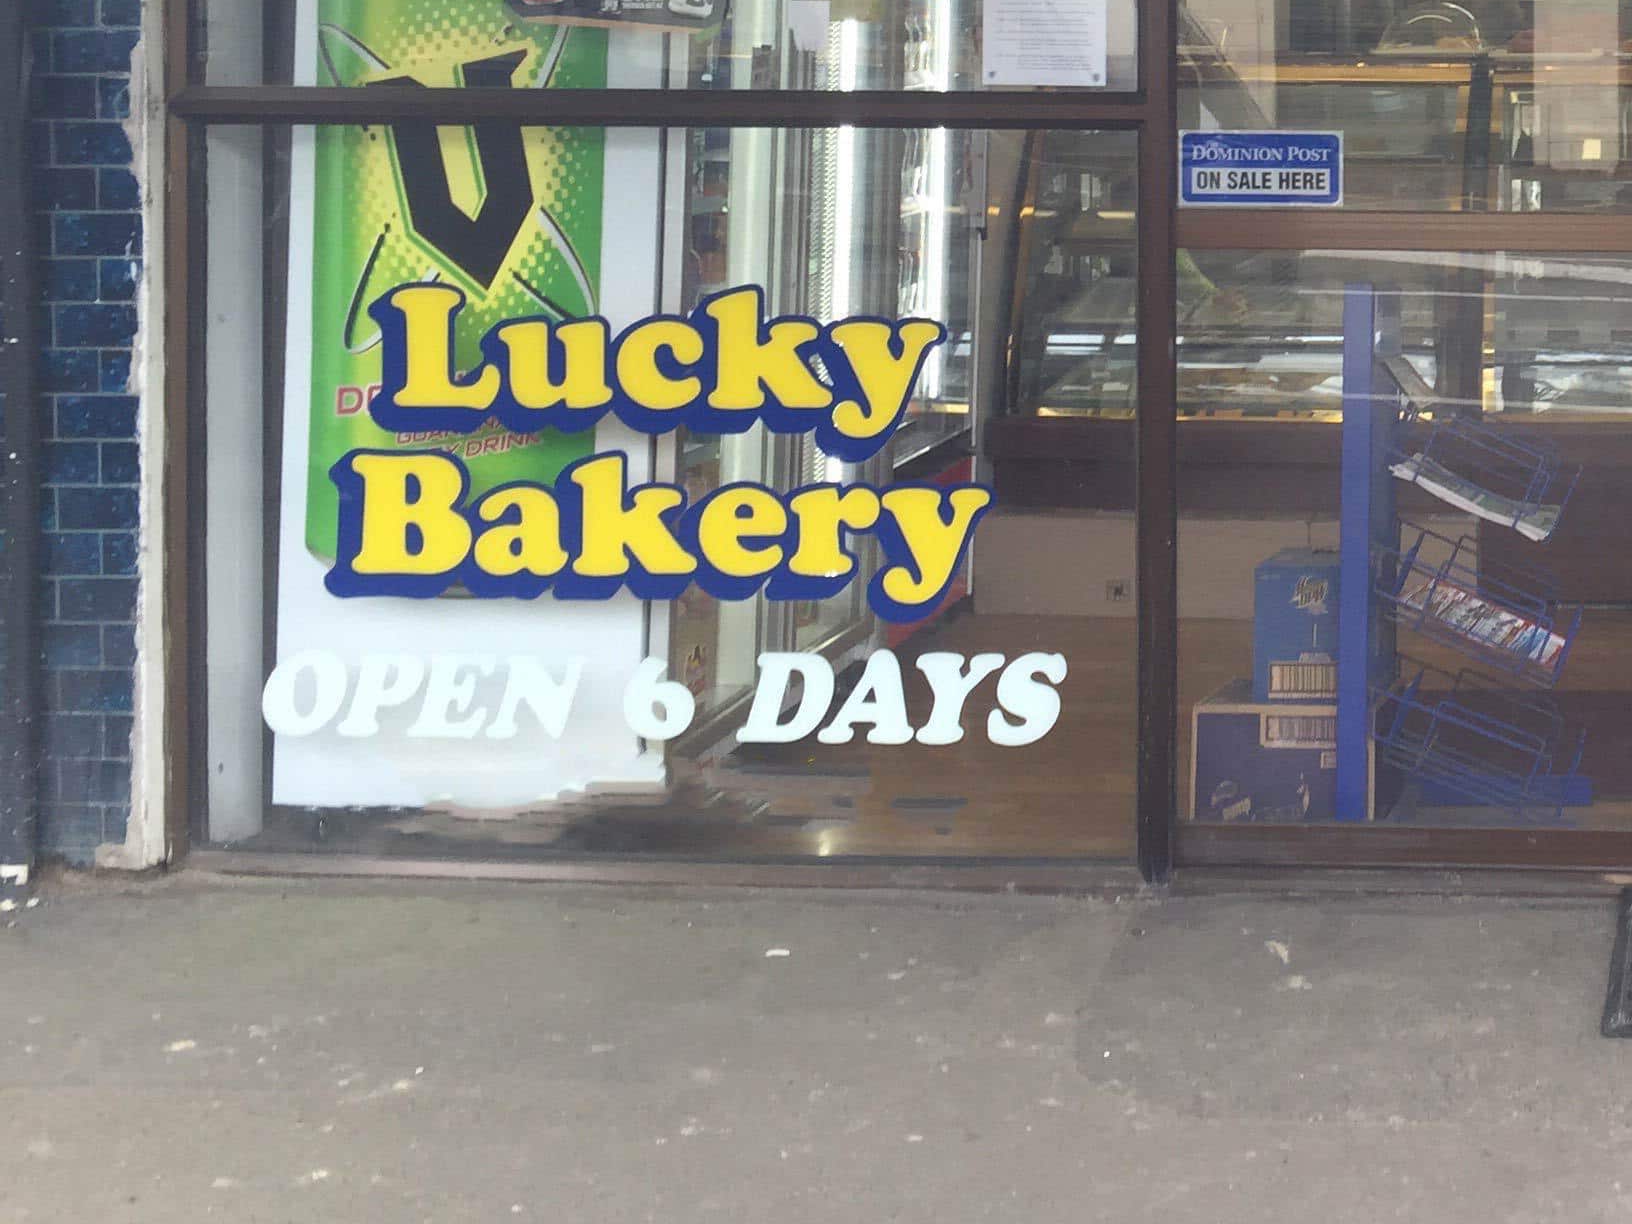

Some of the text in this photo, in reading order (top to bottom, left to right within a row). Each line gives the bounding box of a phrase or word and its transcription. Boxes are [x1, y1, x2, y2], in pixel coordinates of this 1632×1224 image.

[1192, 145, 1332, 162] DOMINION POST
[1197, 171, 1326, 190] ON SALE HERE
[378, 283, 945, 450] Lucky
[335, 451, 993, 614] Bakery
[262, 649, 1068, 747] OPEN 6 DAYS
